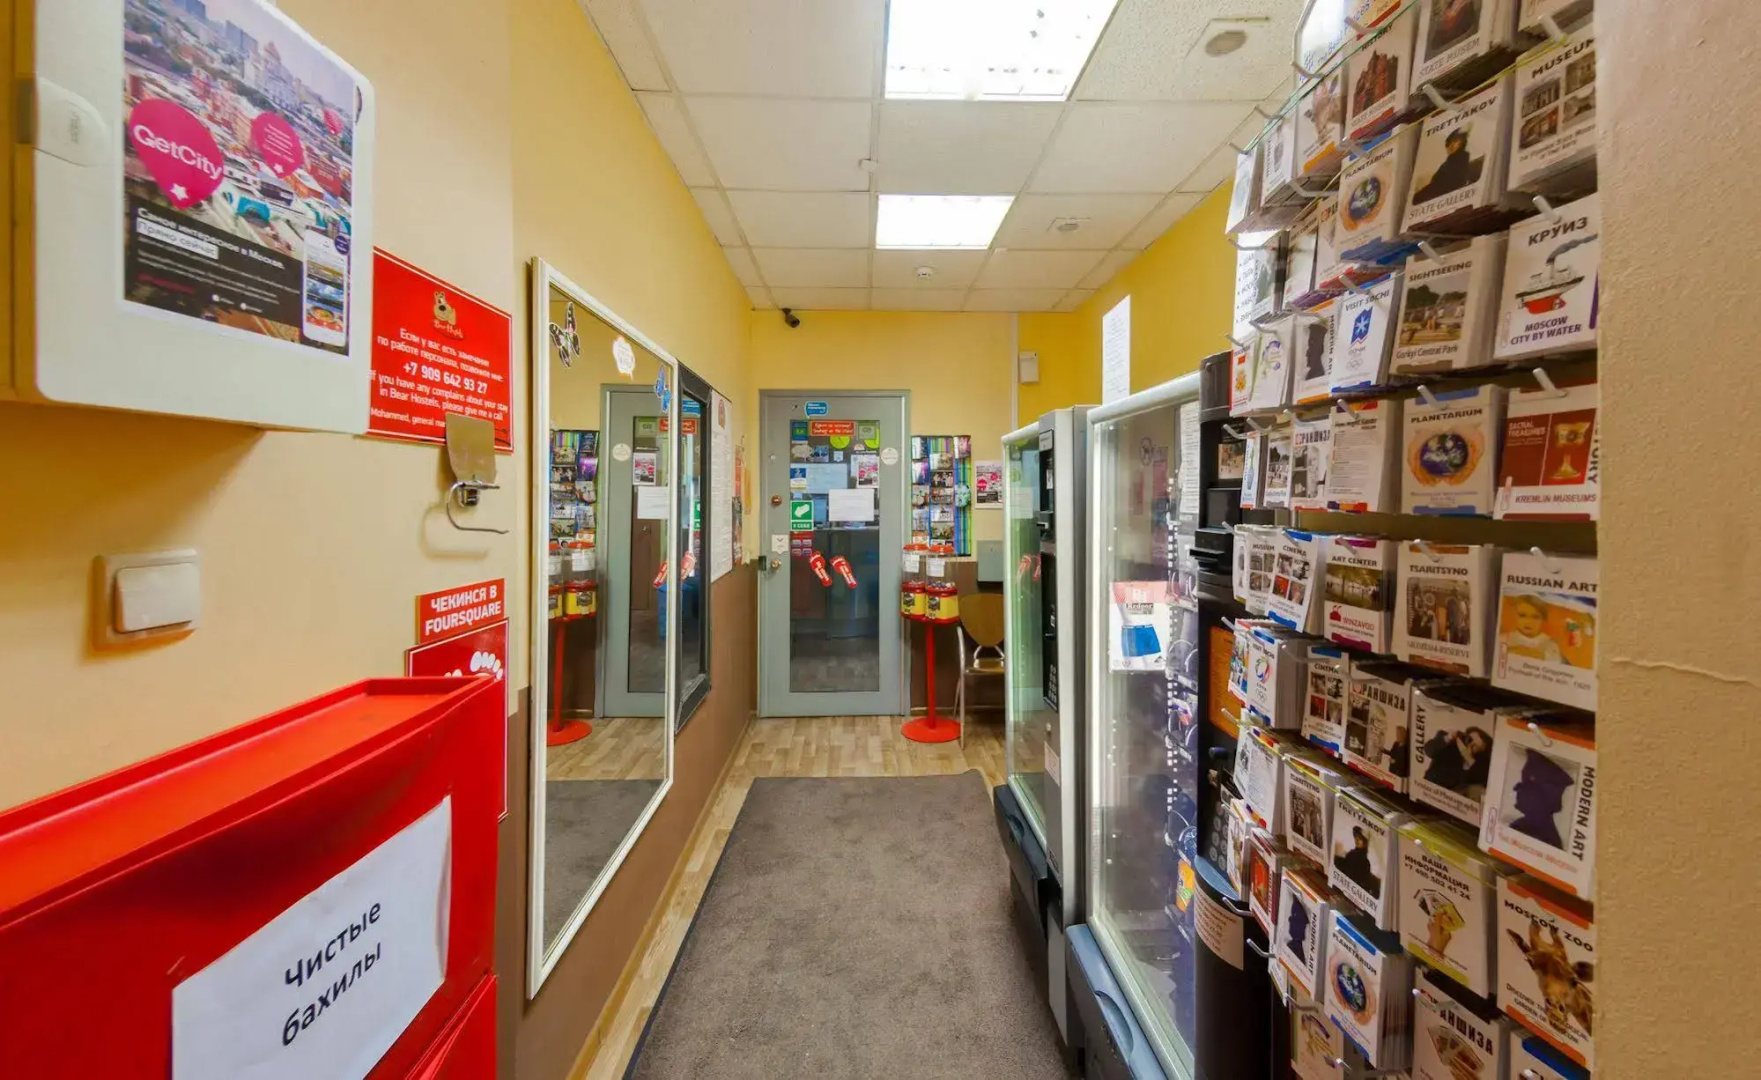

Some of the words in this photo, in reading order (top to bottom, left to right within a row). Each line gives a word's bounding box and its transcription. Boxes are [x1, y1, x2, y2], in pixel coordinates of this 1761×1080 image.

[1425, 95, 1498, 138] TRETYAKOV
[132, 123, 223, 180] GetCity
[1344, 147, 1394, 179] PLANETARIUM
[1409, 202, 1436, 219] STATE
[1436, 188, 1477, 209] GALLERY
[136, 207, 177, 231] Самое
[177, 224, 240, 254] интересное
[240, 246, 248, 256] в
[136, 220, 178, 242] Прямо
[179, 236, 217, 257] сейчас
[1527, 216, 1589, 247] КРУИЗ
[1408, 261, 1473, 282] SIGHTSEEING
[1345, 297, 1364, 311] VISIT
[1365, 289, 1390, 304] SOCHI
[1510, 334, 1531, 346] CITY
[1532, 331, 1545, 341] BY
[1546, 323, 1582, 339] WATER
[1524, 316, 1569, 333] MOSCOW
[377, 336, 389, 347] по
[390, 339, 420, 357] работе
[399, 327, 420, 345] Если
[420, 339, 427, 348] у
[428, 340, 441, 351] вас
[441, 344, 457, 356] есть
[457, 350, 490, 367] замечания
[1417, 345, 1442, 357] Central
[1442, 343, 1459, 354] Park
[378, 373, 395, 390] you
[396, 375, 415, 390] have
[416, 381, 431, 395] any
[465, 392, 483, 405] about
[483, 399, 497, 410] your
[497, 402, 509, 413] stay
[402, 361, 418, 376] +7
[420, 364, 441, 382] 909
[443, 371, 462, 389] 642
[463, 378, 476, 392] 93
[476, 382, 488, 394] 27
[370, 407, 411, 423] Mohammed,
[411, 415, 434, 427] general
[379, 386, 388, 397] in
[389, 387, 410, 402] Bear
[410, 393, 441, 409] Hostels,
[442, 398, 464, 414] please
[464, 405, 478, 417] give
[478, 408, 488, 418] me
[488, 411, 493, 419] a
[493, 411, 504, 421] call
[1410, 408, 1483, 423] PLANETARIUM
[1515, 494, 1551, 504] KREMLIN
[1552, 493, 1597, 504] MUSEUMS
[1282, 545, 1307, 557] CINEMA
[1332, 555, 1346, 564] ART
[1347, 557, 1378, 567] CENTER
[1409, 564, 1469, 576] TSARITSYNO
[1507, 574, 1565, 589] RUSSIAN
[1567, 581, 1598, 593] ART
[431, 587, 487, 613] ЧЕКИНСЯ
[489, 584, 498, 599] В
[425, 601, 502, 636] FOURSQUARE
[1314, 663, 1339, 674] CINEMA
[1416, 704, 1427, 763] GALLERY
[1575, 765, 1595, 828] MODERN
[1337, 801, 1386, 837] TRETYAKOV
[1571, 829, 1585, 862] ART
[1404, 854, 1470, 892] ИНФОРМАЦИЯ
[1421, 854, 1449, 873] ВАША
[1333, 870, 1351, 889] STATE
[1351, 883, 1378, 910] GALLERY
[1404, 862, 1413, 874] +7
[1431, 875, 1446, 888] 502
[1459, 889, 1471, 901] 24
[1309, 912, 1317, 951] MODERN
[1504, 899, 1560, 935] MOSCOW
[1564, 930, 1594, 953] ZOO
[283, 901, 381, 989] Чистые
[1332, 933, 1378, 976] PLANETARIUM
[1307, 953, 1315, 976] ART
[281, 942, 382, 1047] бахилы
